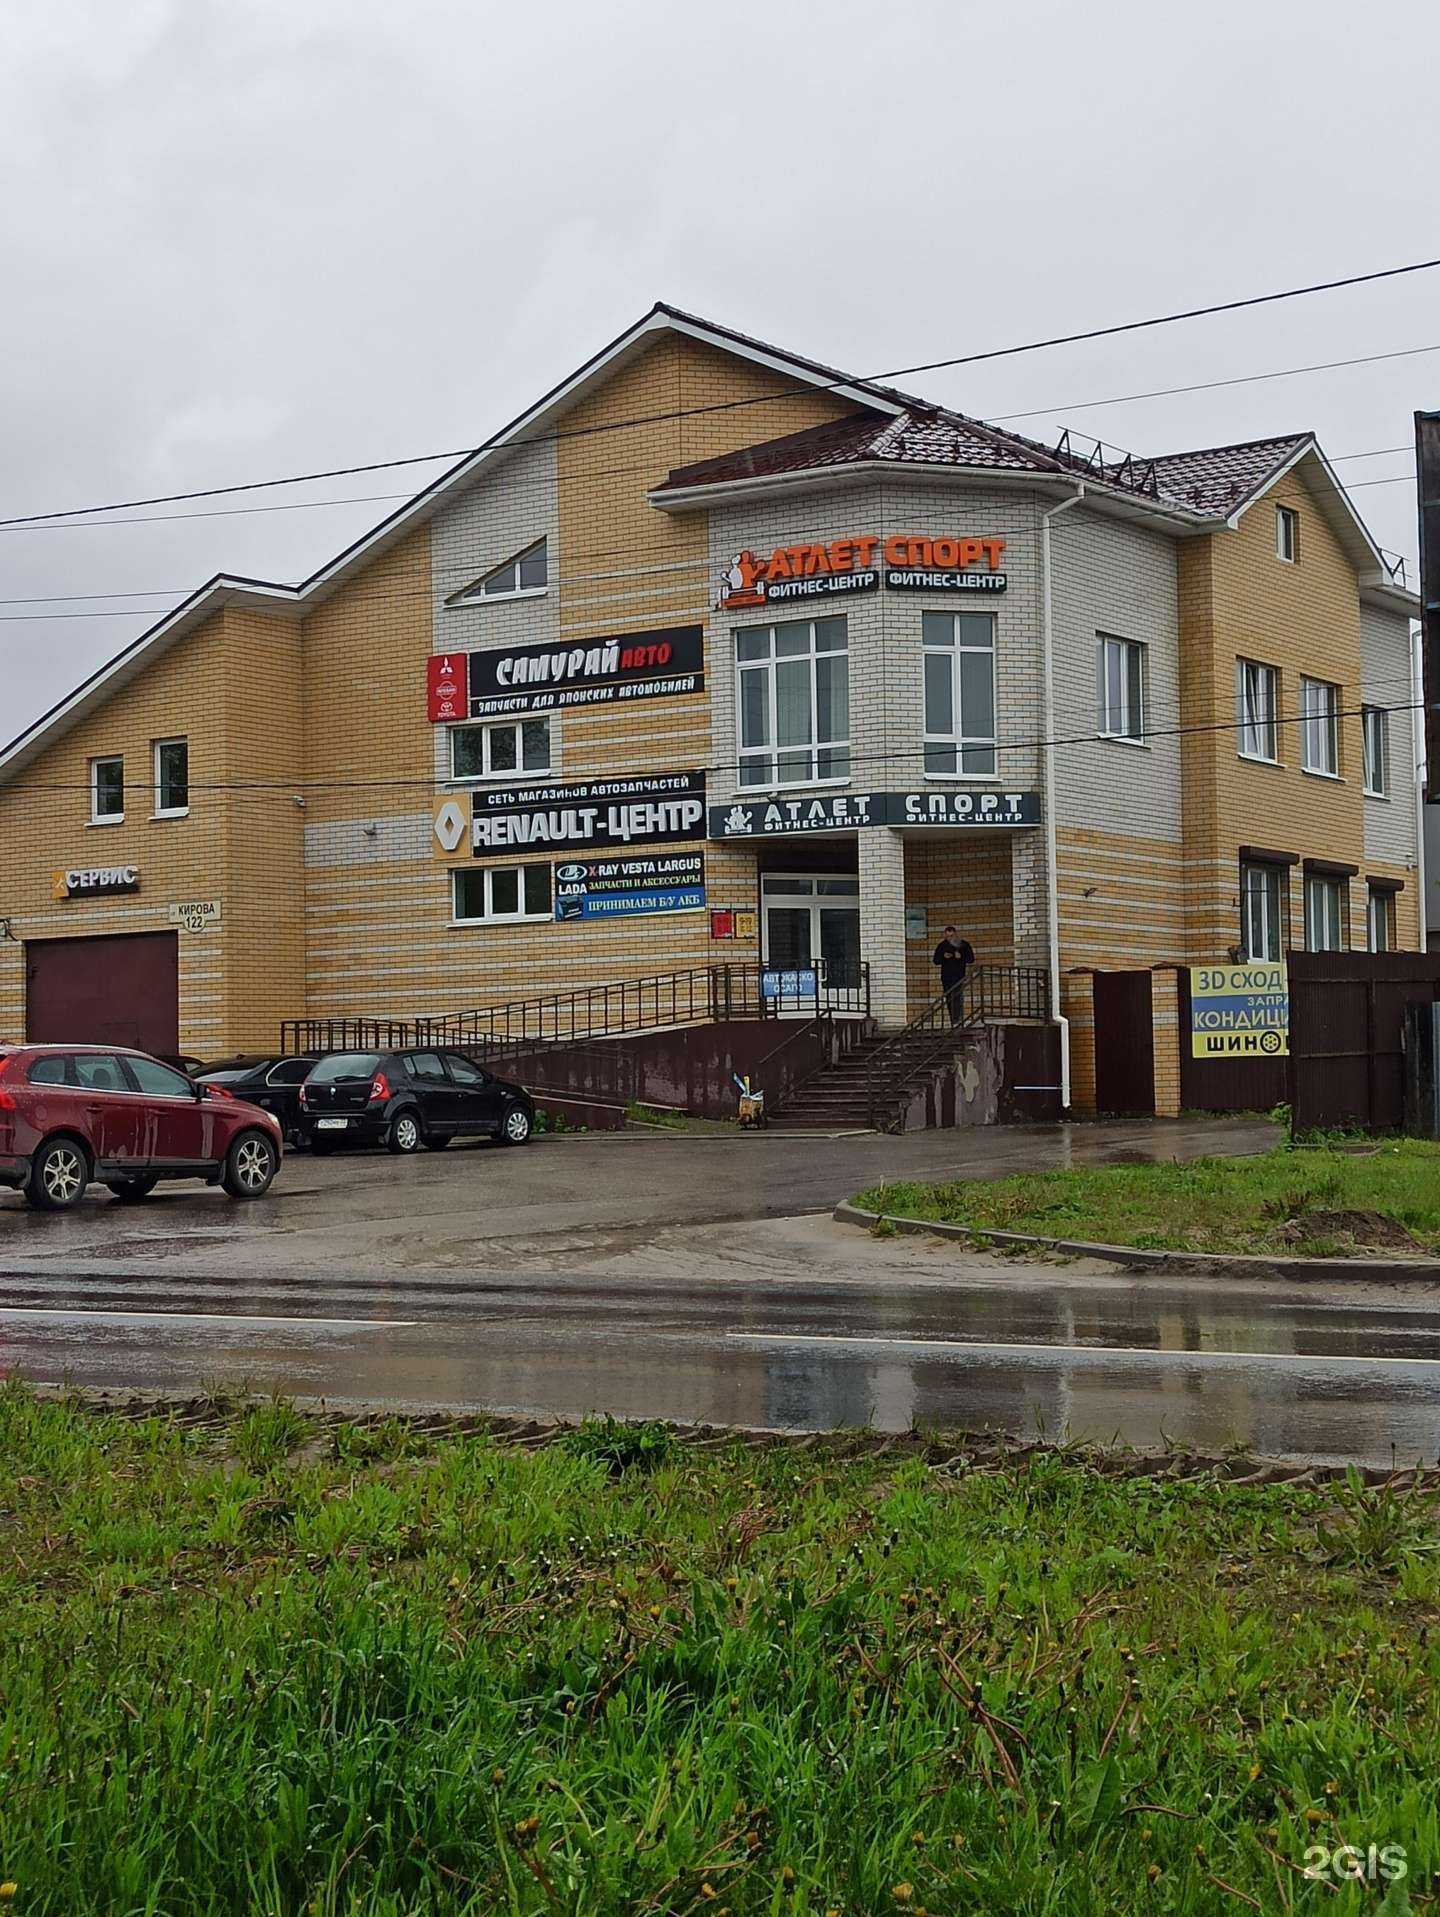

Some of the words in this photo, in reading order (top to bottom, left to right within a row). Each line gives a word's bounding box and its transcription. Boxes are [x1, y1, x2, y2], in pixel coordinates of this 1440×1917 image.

[767, 535, 879, 580] АТЛЕТ
[884, 535, 1006, 569] СПОРТ
[768, 571, 875, 599] ФИТНЕС-ЦЕНТР
[889, 571, 1006, 589] ФИТНЕС-ЦЕНТР
[496, 639, 621, 686] САМУРАЙ
[621, 642, 672, 669] АВТО
[478, 697, 528, 713] ЗАПЧАСТИ
[532, 695, 554, 710] ДЛЯ
[559, 687, 614, 705] ЯПОНСКИХ
[618, 676, 695, 698] АВТОМОБИЛЕЙ
[488, 792, 515, 805] СЕТЬ
[518, 786, 587, 803] МАГАЗИНОВ
[590, 775, 689, 796] АВТОЗАПЧАСТЕЙ
[764, 796, 871, 823] АТЛЕТ
[904, 794, 1023, 814] СПОРТ
[906, 813, 1023, 823] ФИТНЕС-ЦЕНТР
[473, 799, 702, 848] RENAULT-ЦЕНТР
[764, 815, 871, 832] ФИТНЕС-ЦЕНТР
[621, 861, 655, 875] VESTA
[658, 858, 701, 872] LARGUS
[65, 865, 139, 889] СЕРВИС
[589, 879, 633, 890] ЗАПЧАСТИ
[634, 879, 641, 887] И
[642, 874, 701, 887] АКСЕССУАРЫ
[558, 883, 588, 895] LADA
[178, 903, 215, 916] КИРОВА
[588, 897, 656, 912] ПРИНИМАЕМ
[659, 896, 676, 908] Б/У
[678, 894, 700, 906] АКБ
[186, 916, 203, 928] 122
[1199, 970, 1226, 990] 3D
[1230, 970, 1282, 991] СХОД
